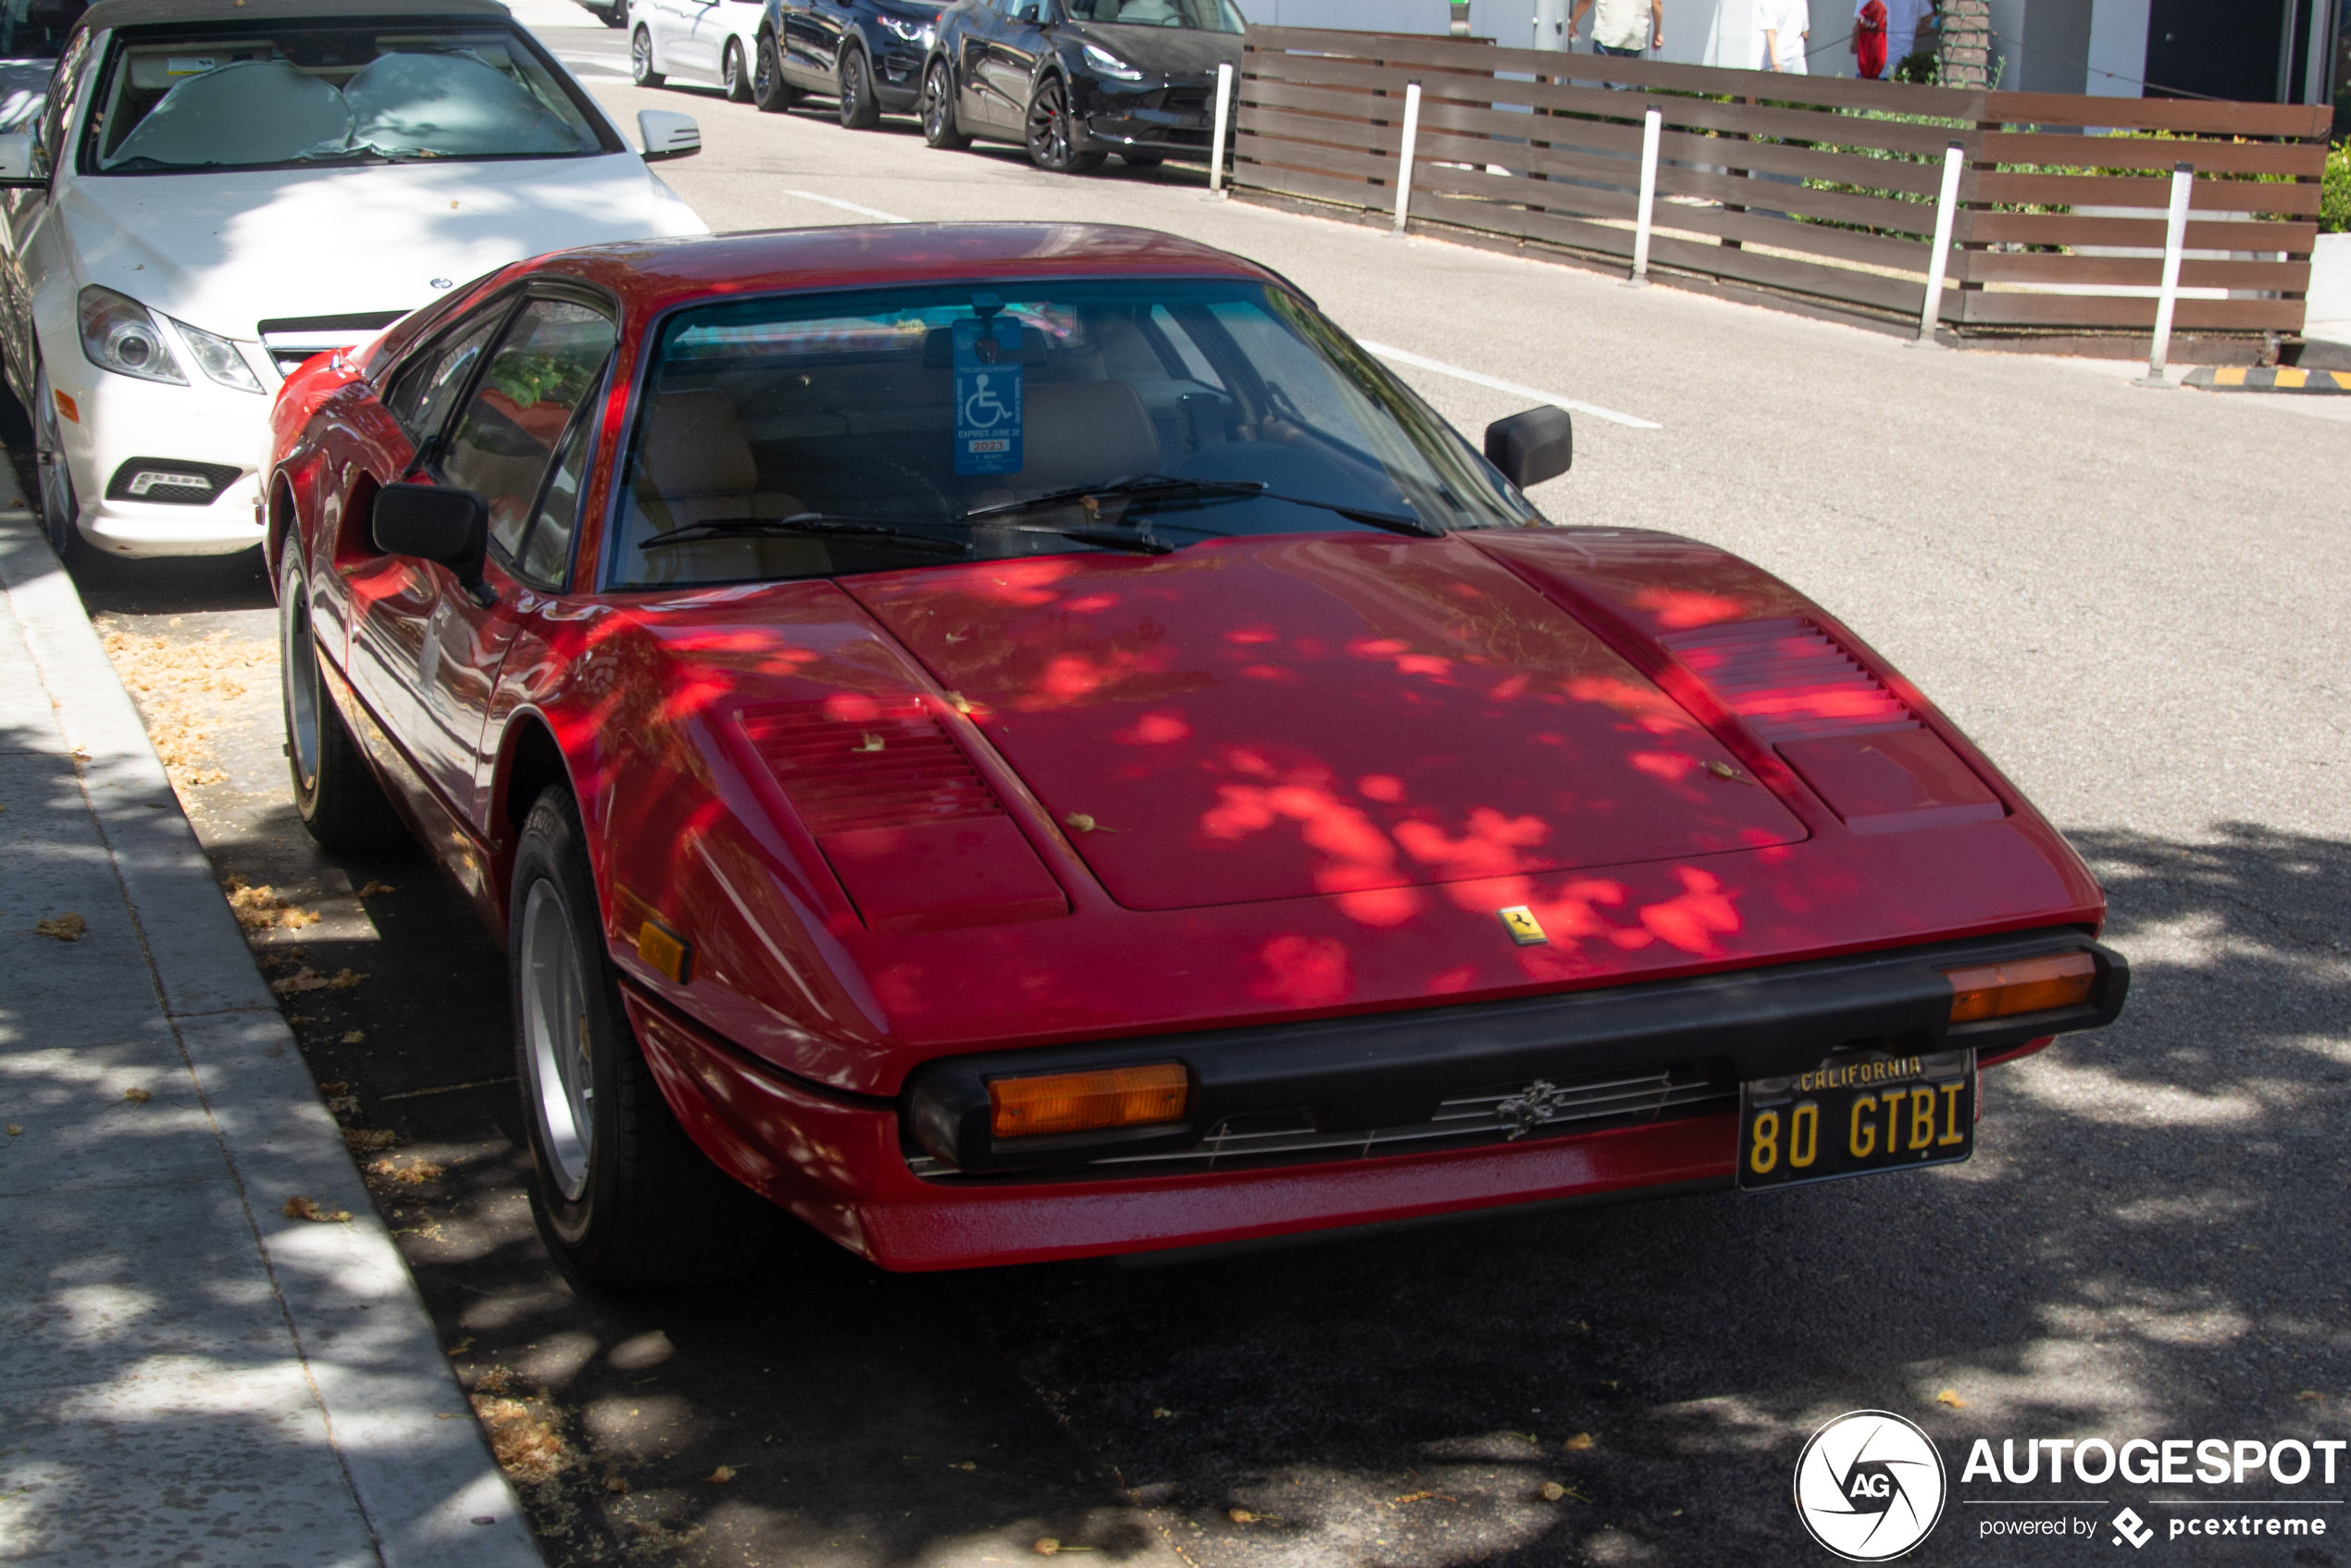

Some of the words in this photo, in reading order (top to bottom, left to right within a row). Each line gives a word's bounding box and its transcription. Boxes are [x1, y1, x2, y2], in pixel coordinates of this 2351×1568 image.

[958, 429, 989, 439] EXPIRES
[991, 429, 1010, 437] JUNE
[974, 442, 1003, 451] 2023
[1801, 1056, 1922, 1092] CALIFORNIA
[1750, 1102, 1819, 1175] 80
[1849, 1082, 1964, 1158] GTBI
